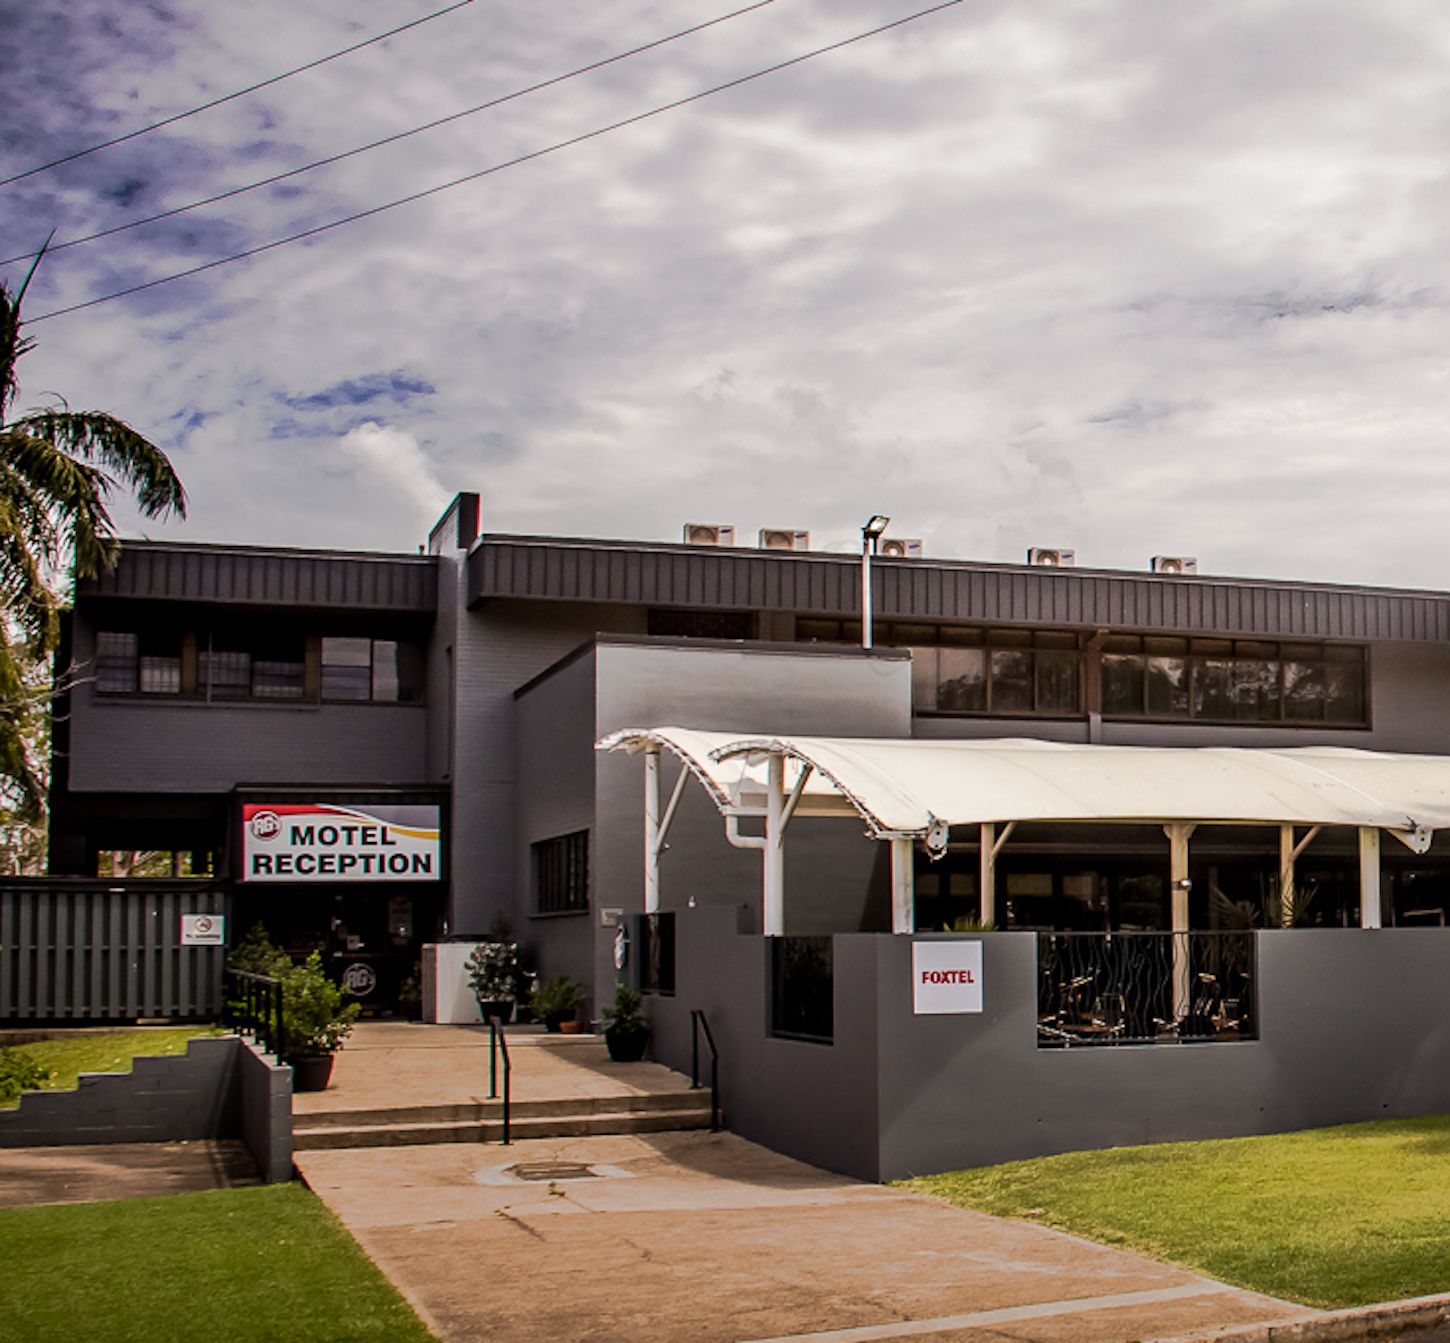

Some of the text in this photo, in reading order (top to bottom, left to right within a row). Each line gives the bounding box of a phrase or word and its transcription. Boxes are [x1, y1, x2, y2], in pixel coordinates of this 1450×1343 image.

[291, 825, 396, 846] MOTEL
[252, 853, 432, 875] RECEPTION
[922, 970, 975, 984] FOXTEL
